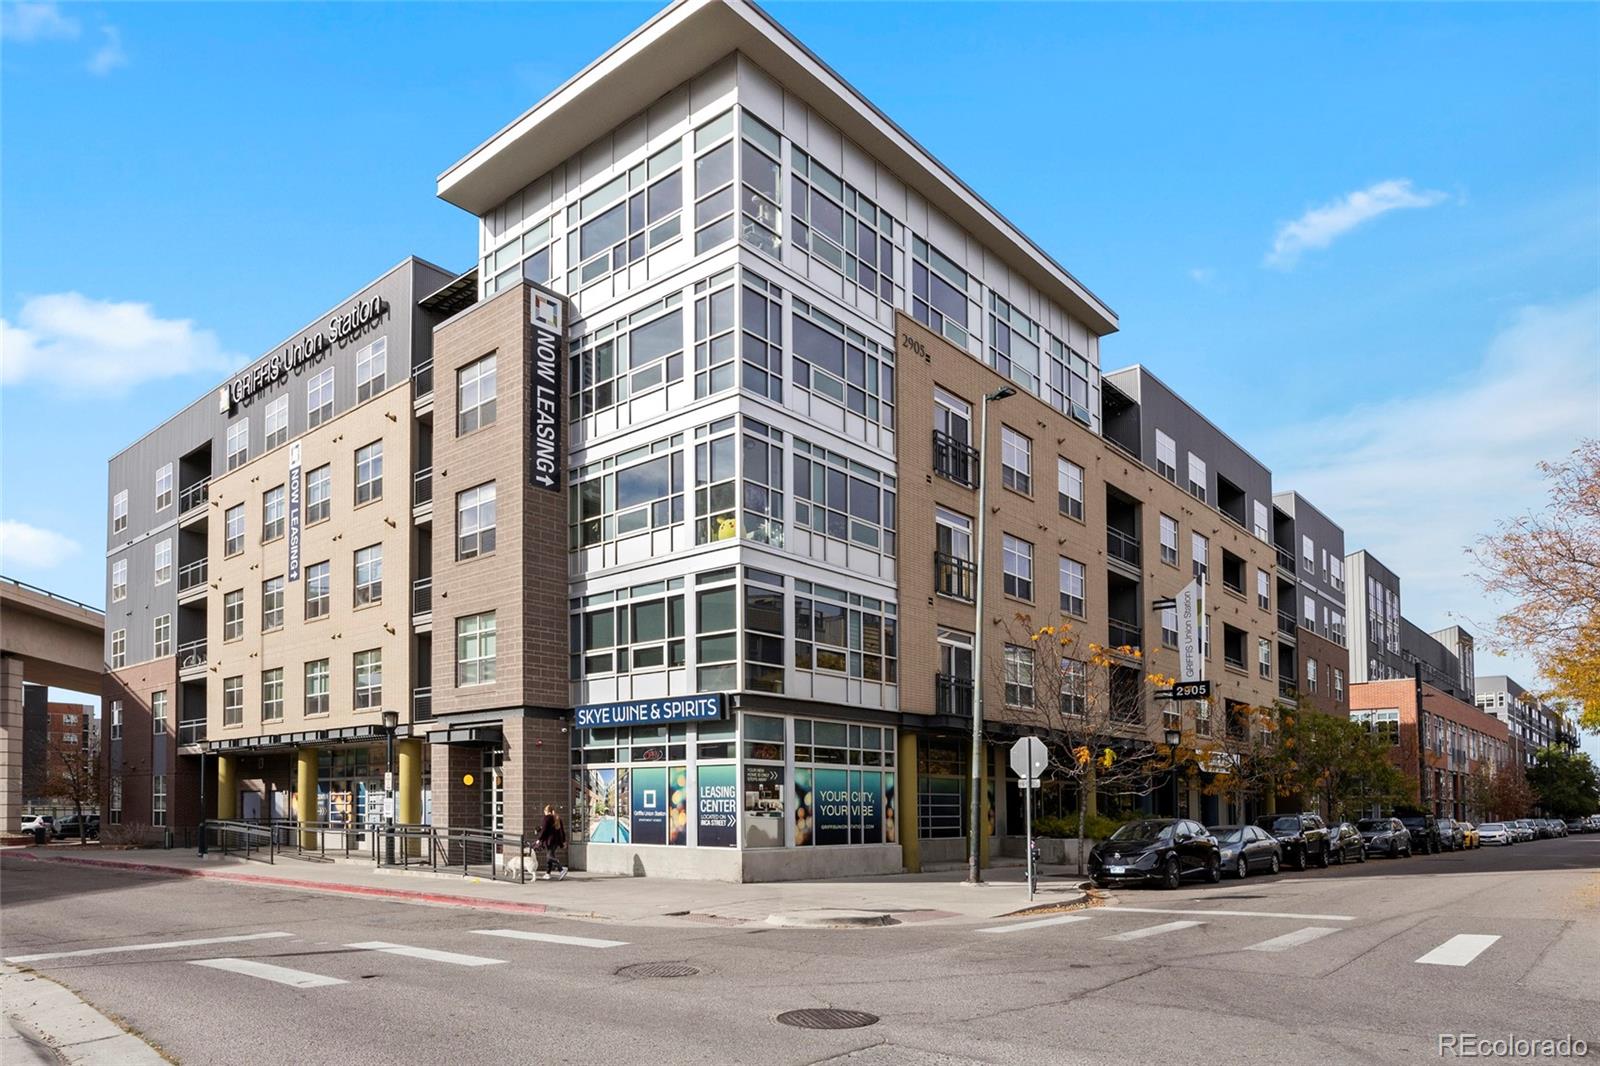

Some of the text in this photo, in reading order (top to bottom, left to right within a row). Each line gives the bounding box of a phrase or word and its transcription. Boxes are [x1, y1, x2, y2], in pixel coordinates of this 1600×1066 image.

[233, 295, 381, 403] GRIFFIS Union Station
[902, 333, 925, 358] 2905
[536, 329, 556, 473] NOW LEASING
[290, 469, 299, 570] NOW LEASING
[1184, 591, 1194, 678] GRIFFIS Union Station
[1176, 685, 1206, 696] 2905
[578, 698, 717, 725] SKYE WINE & SPIRITS
[700, 785, 735, 798] LEASING
[820, 790, 848, 802] YOUR
[700, 799, 736, 812] CENTER
[820, 805, 874, 816] YOUR VIBE
